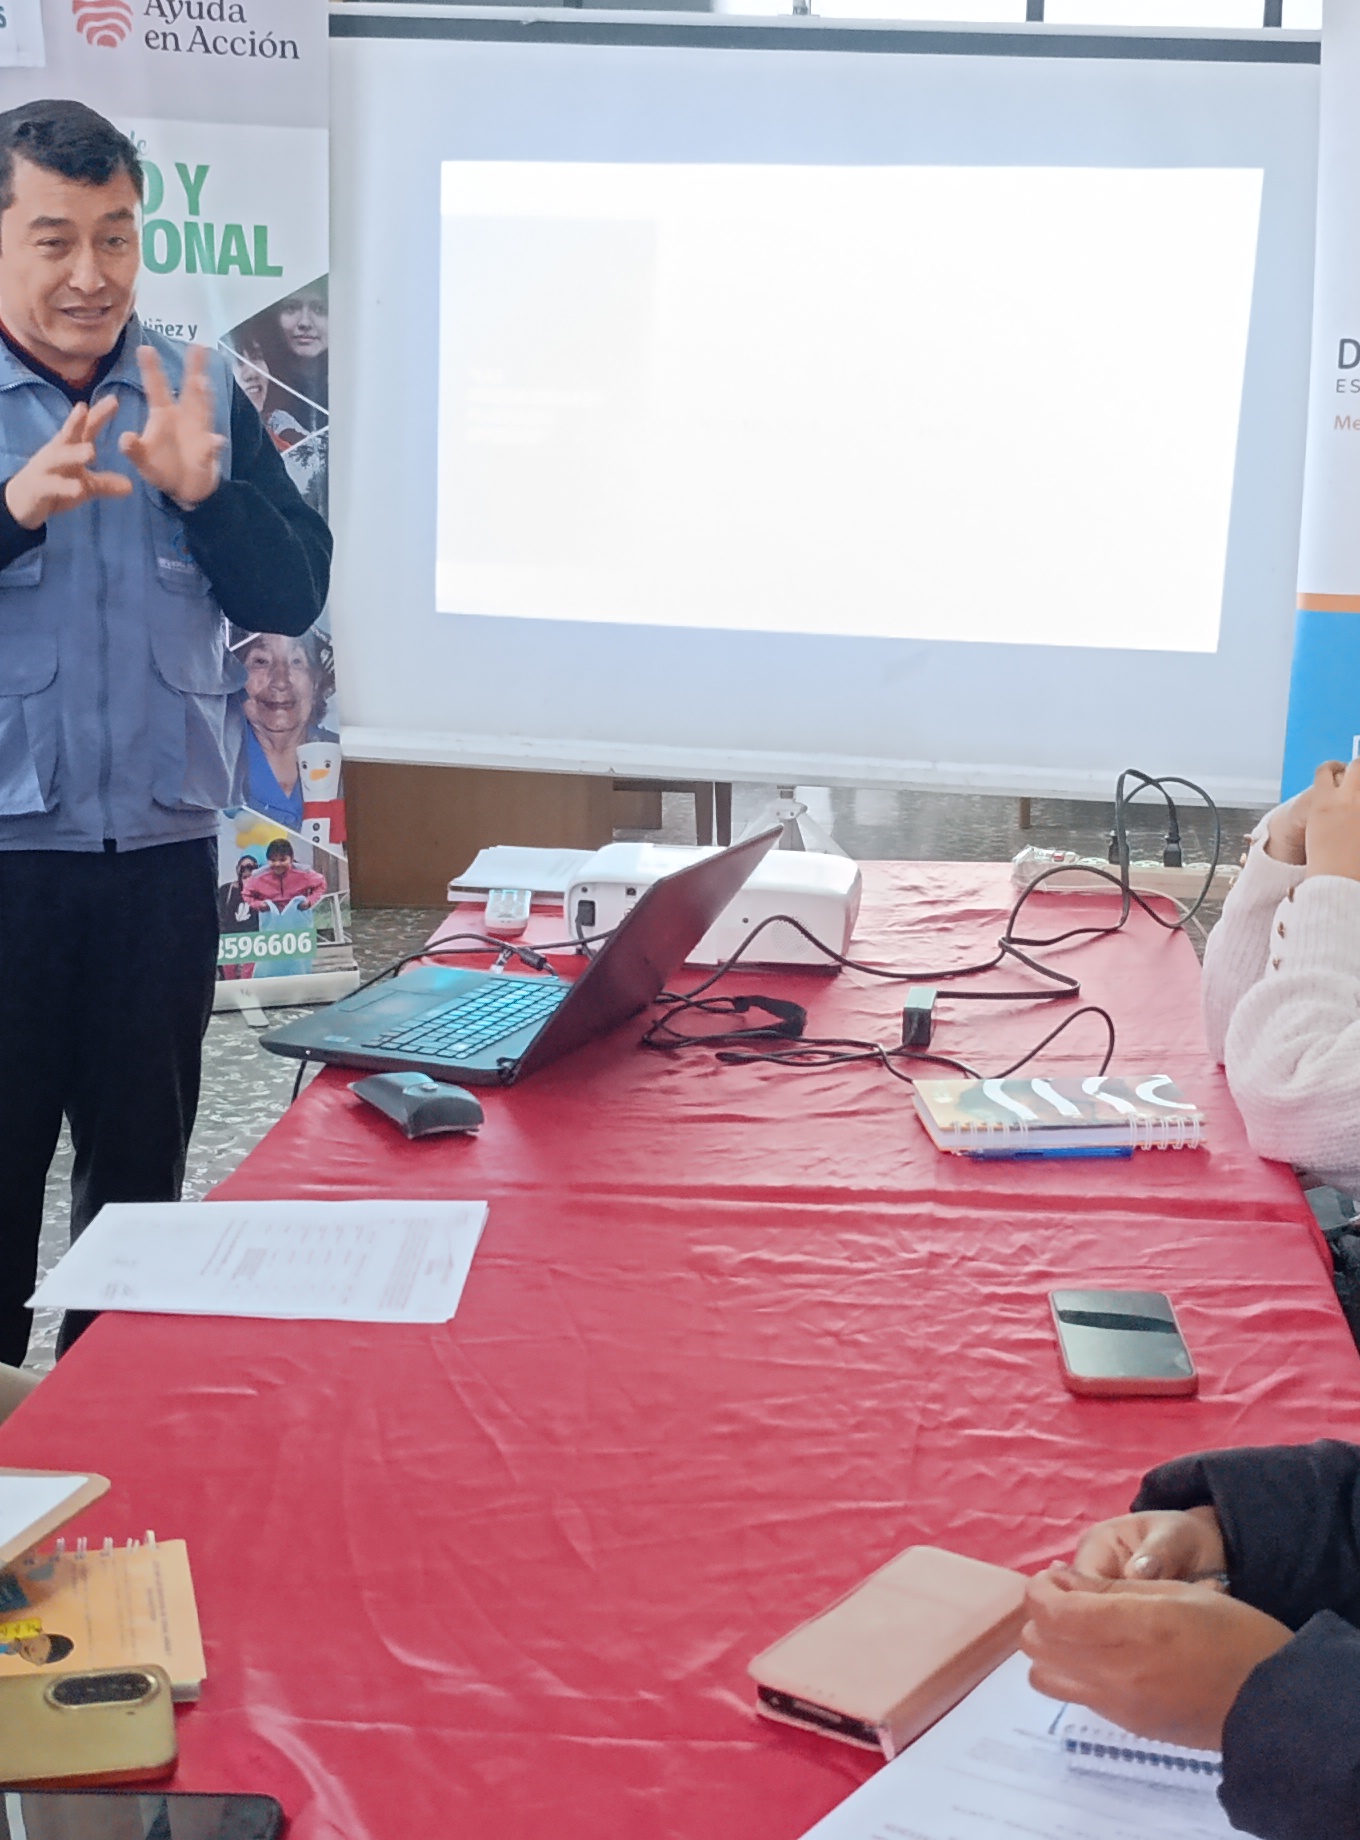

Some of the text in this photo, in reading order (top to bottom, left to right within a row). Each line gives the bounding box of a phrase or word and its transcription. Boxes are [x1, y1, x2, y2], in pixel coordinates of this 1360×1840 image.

[143, 0, 248, 25] Ayuda
[144, 25, 300, 60] en Acción
[174, 161, 210, 217] Y
[188, 323, 198, 341] y
